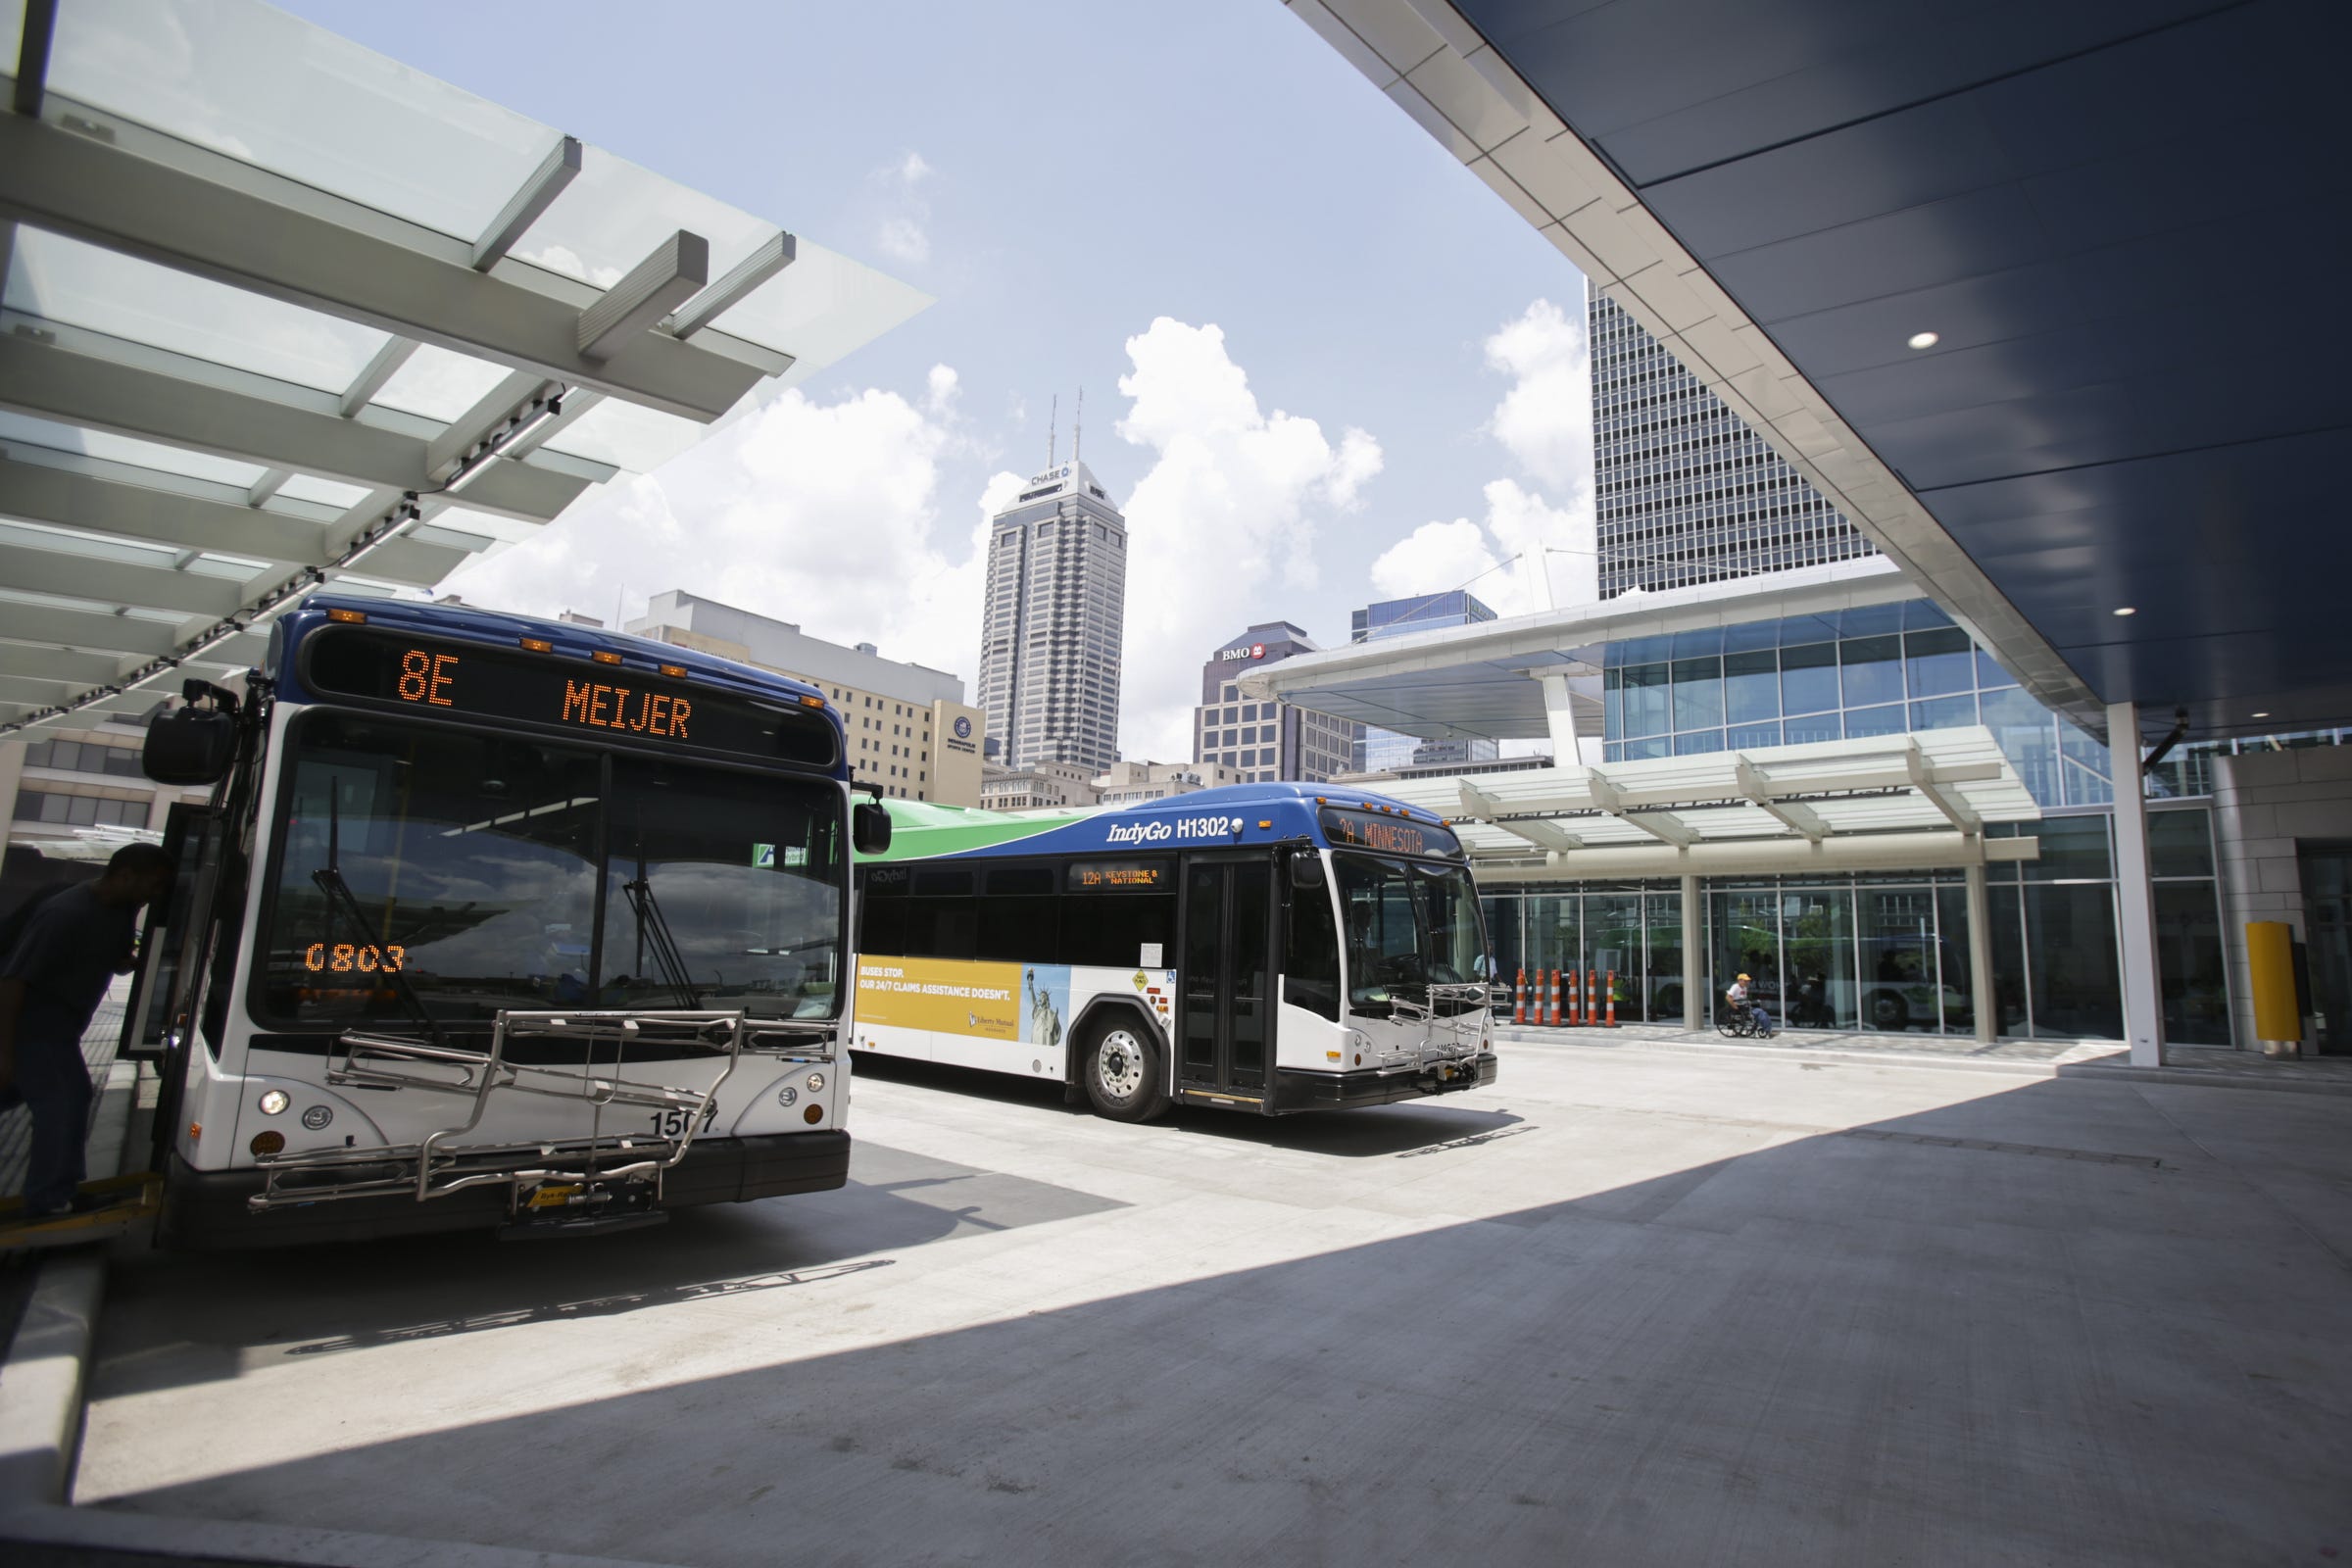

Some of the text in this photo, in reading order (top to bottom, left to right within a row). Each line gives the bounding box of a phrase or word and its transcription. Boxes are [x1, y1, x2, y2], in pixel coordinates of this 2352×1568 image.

[1031, 469, 1060, 486] CHASE
[1222, 647, 1250, 662] BMO
[398, 650, 691, 739] 8E MEIJER
[1105, 816, 1229, 845] IndyGo H1302
[1363, 822, 1423, 855] MINNESOTA
[1082, 871, 1102, 885] 12A
[1105, 869, 1150, 878] KEYSTONE
[305, 943, 405, 972] 0803
[859, 965, 883, 977] BUSES
[859, 979, 1010, 1002] OUR 24/7 CLAIMS ASSISTANCE DOESN'T.
[996, 1018, 1014, 1027] Mutual
